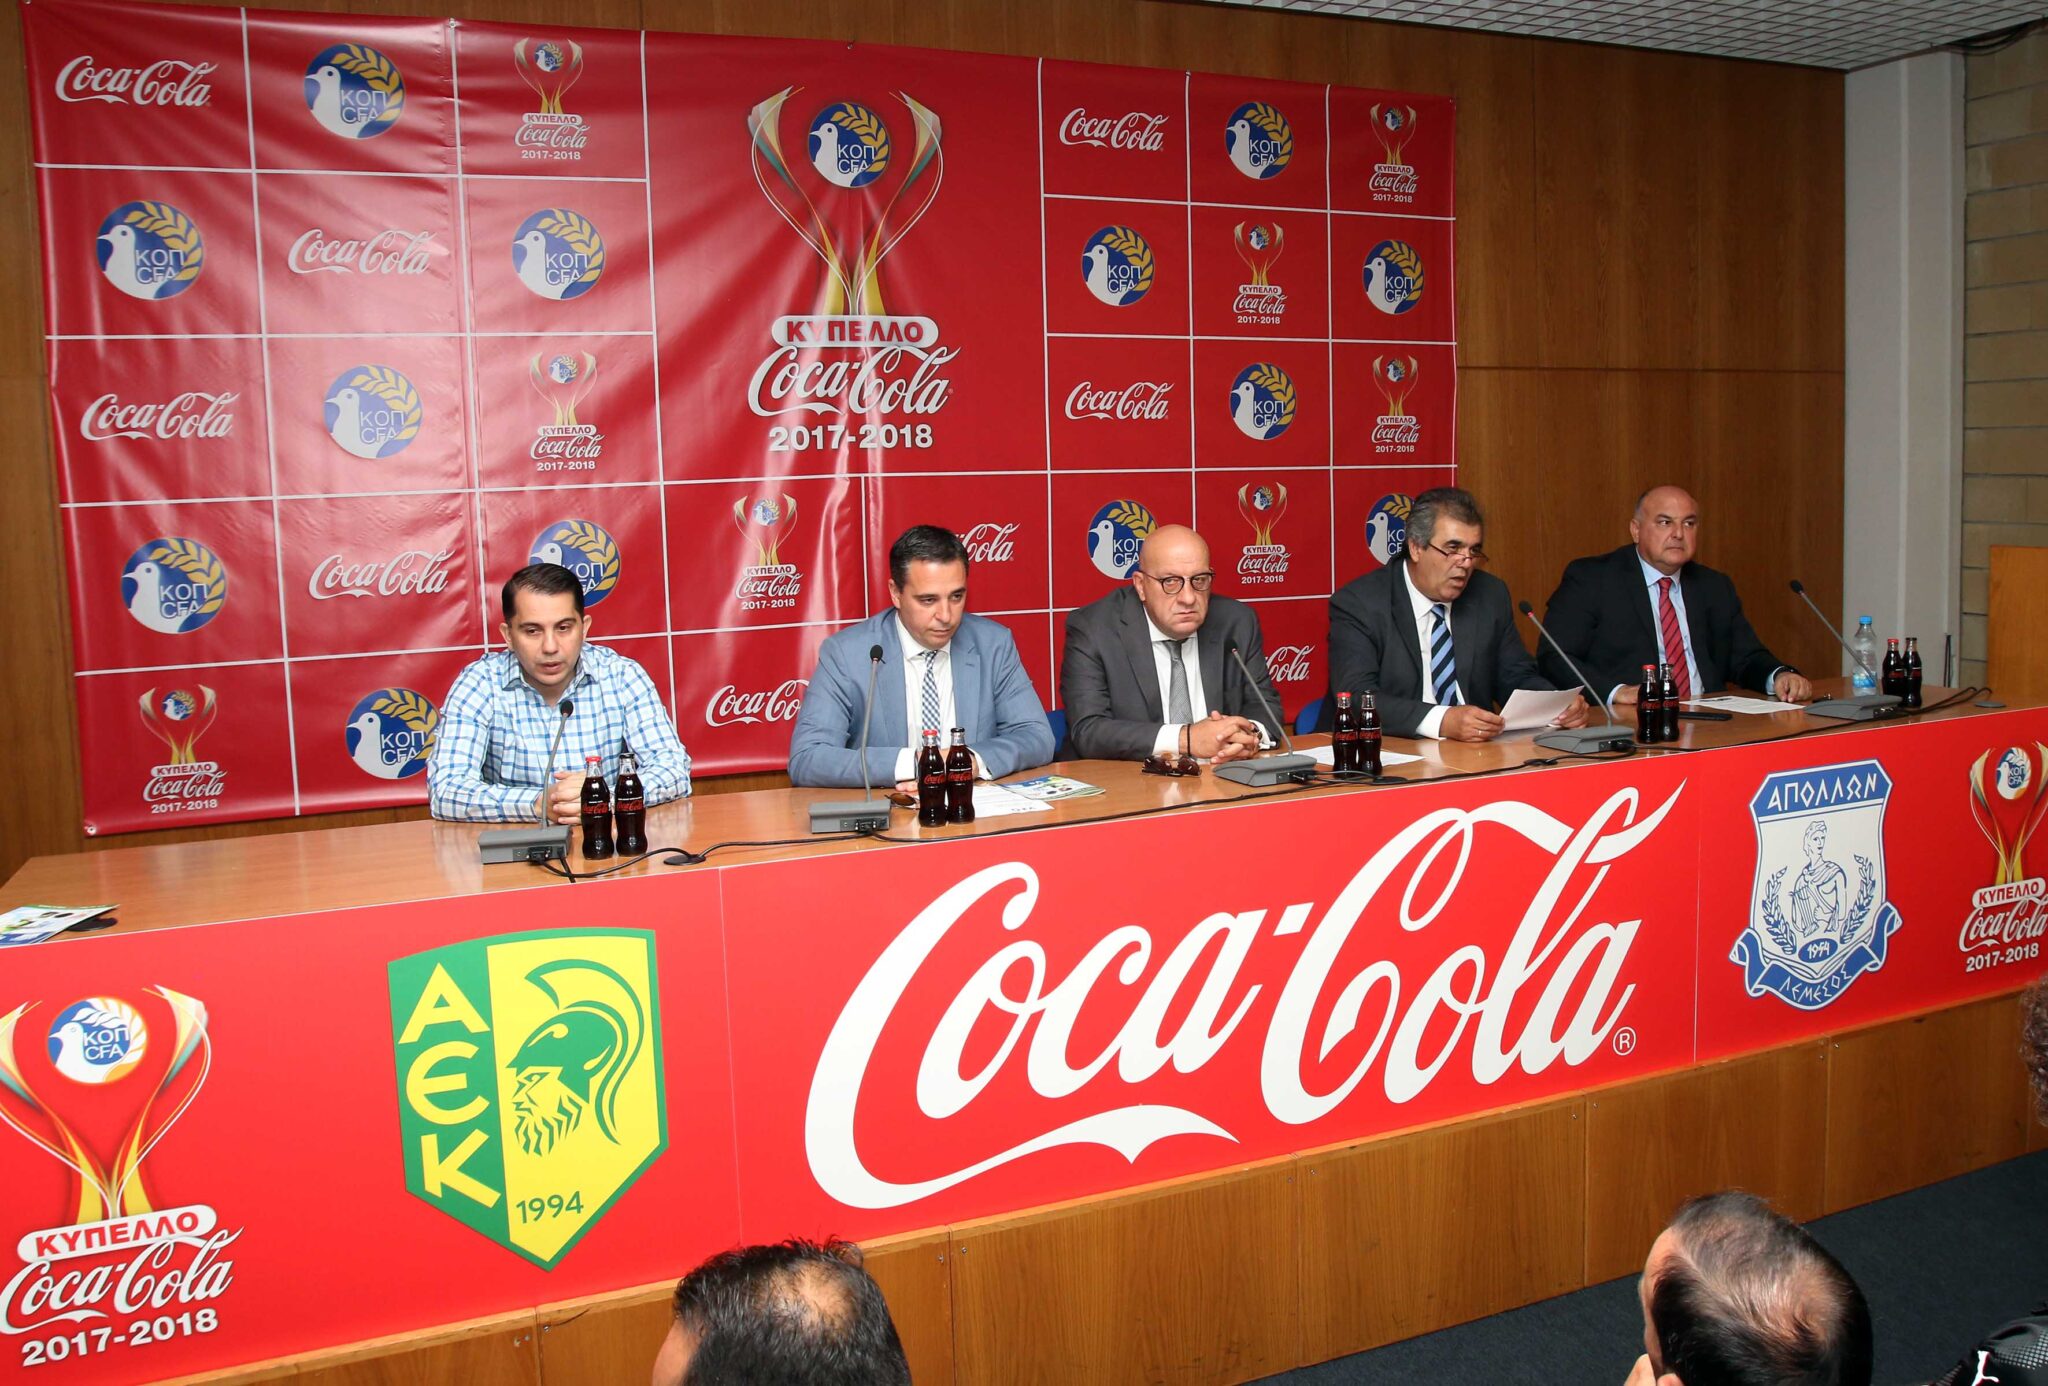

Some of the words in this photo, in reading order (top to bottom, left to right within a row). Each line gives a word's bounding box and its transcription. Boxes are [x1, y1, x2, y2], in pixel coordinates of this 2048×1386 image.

[55, 55, 219, 107] Coca-Cola
[341, 89, 387, 107] ΚΟΠ
[341, 105, 379, 124] CFA
[526, 114, 580, 125] ΚΥΠΕΛΛΟ
[514, 122, 591, 150] Coca-Cola
[1059, 107, 1169, 152] Coca-Cola
[521, 150, 582, 161] 2017-2018
[837, 144, 875, 160] ΚΟΠ
[1250, 139, 1281, 154] ΚΟΠ
[837, 158, 870, 174] CFA
[1250, 152, 1276, 167] CFA
[1377, 165, 1412, 174] ΚΥΠΕΛΛΟ
[1369, 172, 1419, 194] Coca-Cola
[1373, 193, 1413, 203] 2017-2018
[135, 249, 183, 267] ΚΟΠ
[288, 229, 434, 275] Coca-Cola
[546, 250, 588, 268] ΚΟΠ
[135, 265, 176, 285] CFA
[546, 266, 581, 285] CFA
[1108, 265, 1141, 280] ΚΟΠ
[1108, 278, 1136, 293] CFA
[1243, 286, 1278, 294] ΚΥΠΕΛΛΟ
[1385, 275, 1413, 289] ΚΟΠ
[1232, 292, 1287, 315] Coca-Cola
[1385, 288, 1408, 303] CFA
[1237, 315, 1280, 325] 2017-2018
[787, 321, 923, 342] ΚΥΠΕΛΛΟ
[747, 345, 961, 417] Coca-Cola
[1065, 381, 1174, 421] Coca-Cola
[1254, 401, 1284, 414] ΚΟΠ
[80, 392, 241, 441] Coca-Cola
[360, 410, 404, 428] ΚΟΠ
[1254, 412, 1280, 427] CFA
[1380, 417, 1413, 425] ΚΥΠΕΛΛΟ
[358, 425, 397, 444] CFA
[541, 426, 594, 436] ΚΥΠΕΛΛΟ
[768, 423, 933, 452] 2017-2018
[1371, 423, 1421, 444] Coca-Cola
[529, 433, 605, 459] Coca-Cola
[1375, 445, 1415, 453] 2017-2018
[536, 460, 596, 471] 2017-2018
[1388, 529, 1407, 543] ΚΟ
[1246, 546, 1281, 554] ΚΥΠΕΛΛΟ
[747, 566, 792, 575] ΚΥΠΕΛΛΟ
[1237, 552, 1293, 576] Coca-Cola
[309, 548, 456, 601] Coca-Cola
[1241, 575, 1284, 584] 2017-2018
[160, 583, 206, 602] ΚΟΠ
[735, 573, 803, 599] Coca-Cola
[160, 600, 201, 620] CFA
[741, 598, 795, 610] 2017-2018
[381, 731, 426, 750] ΚΟΠ
[382, 747, 419, 766] CFA
[156, 763, 213, 776] ΚΥΠΕΛΛΟ
[2008, 766, 2025, 778] ΚΟΠ
[142, 769, 227, 802] Coca-Cola
[2008, 775, 2023, 787] CFA
[1766, 772, 1878, 811] ΑΠΟΛΛΩΝ
[150, 798, 218, 815] 2017-2018
[1978, 881, 2039, 905] ΚΥΠΕΛΛΟ
[1965, 943, 2039, 973] 2017-2018
[804, 777, 1688, 1210] Coca-Cola
[83, 1029, 130, 1048] ΚΟΠ
[84, 1043, 125, 1061] CFA
[516, 1190, 585, 1225] 1994
[35, 1211, 199, 1255] ΚΥΠΕΛΛΟ
[0, 1227, 244, 1335] Coca-Cola
[21, 1308, 219, 1367] 2017-2018
